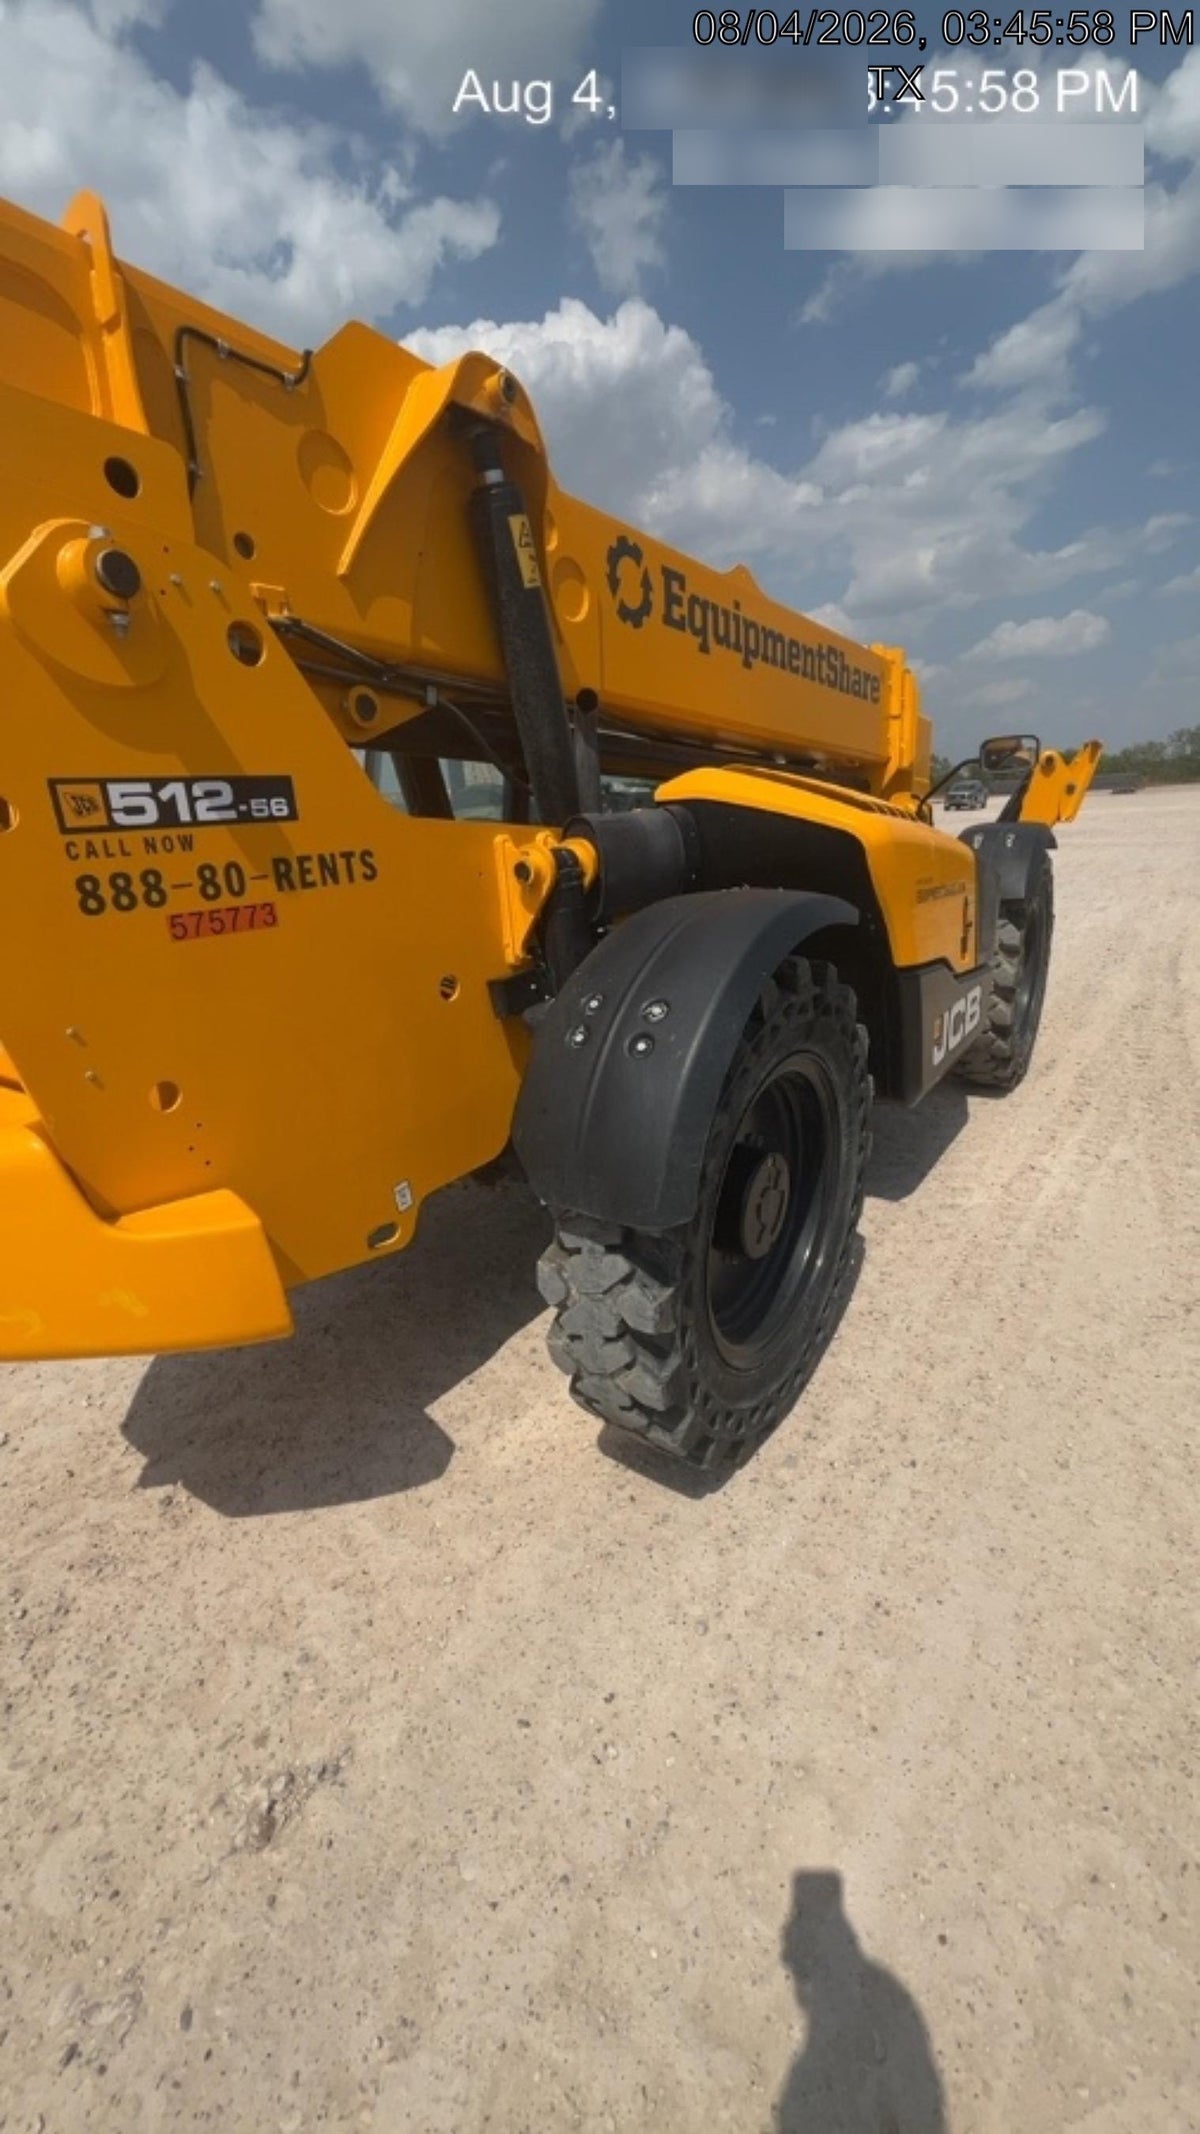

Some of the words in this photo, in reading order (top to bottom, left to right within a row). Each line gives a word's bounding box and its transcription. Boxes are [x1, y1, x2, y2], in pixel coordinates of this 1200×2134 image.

[661, 564, 881, 704] EquipmentShare
[65, 838, 132, 861] CALL
[144, 834, 195, 855] NOW
[75, 850, 378, 916] 888-80-RENTS
[169, 902, 278, 941] 575773
[932, 985, 982, 1066] JCB
